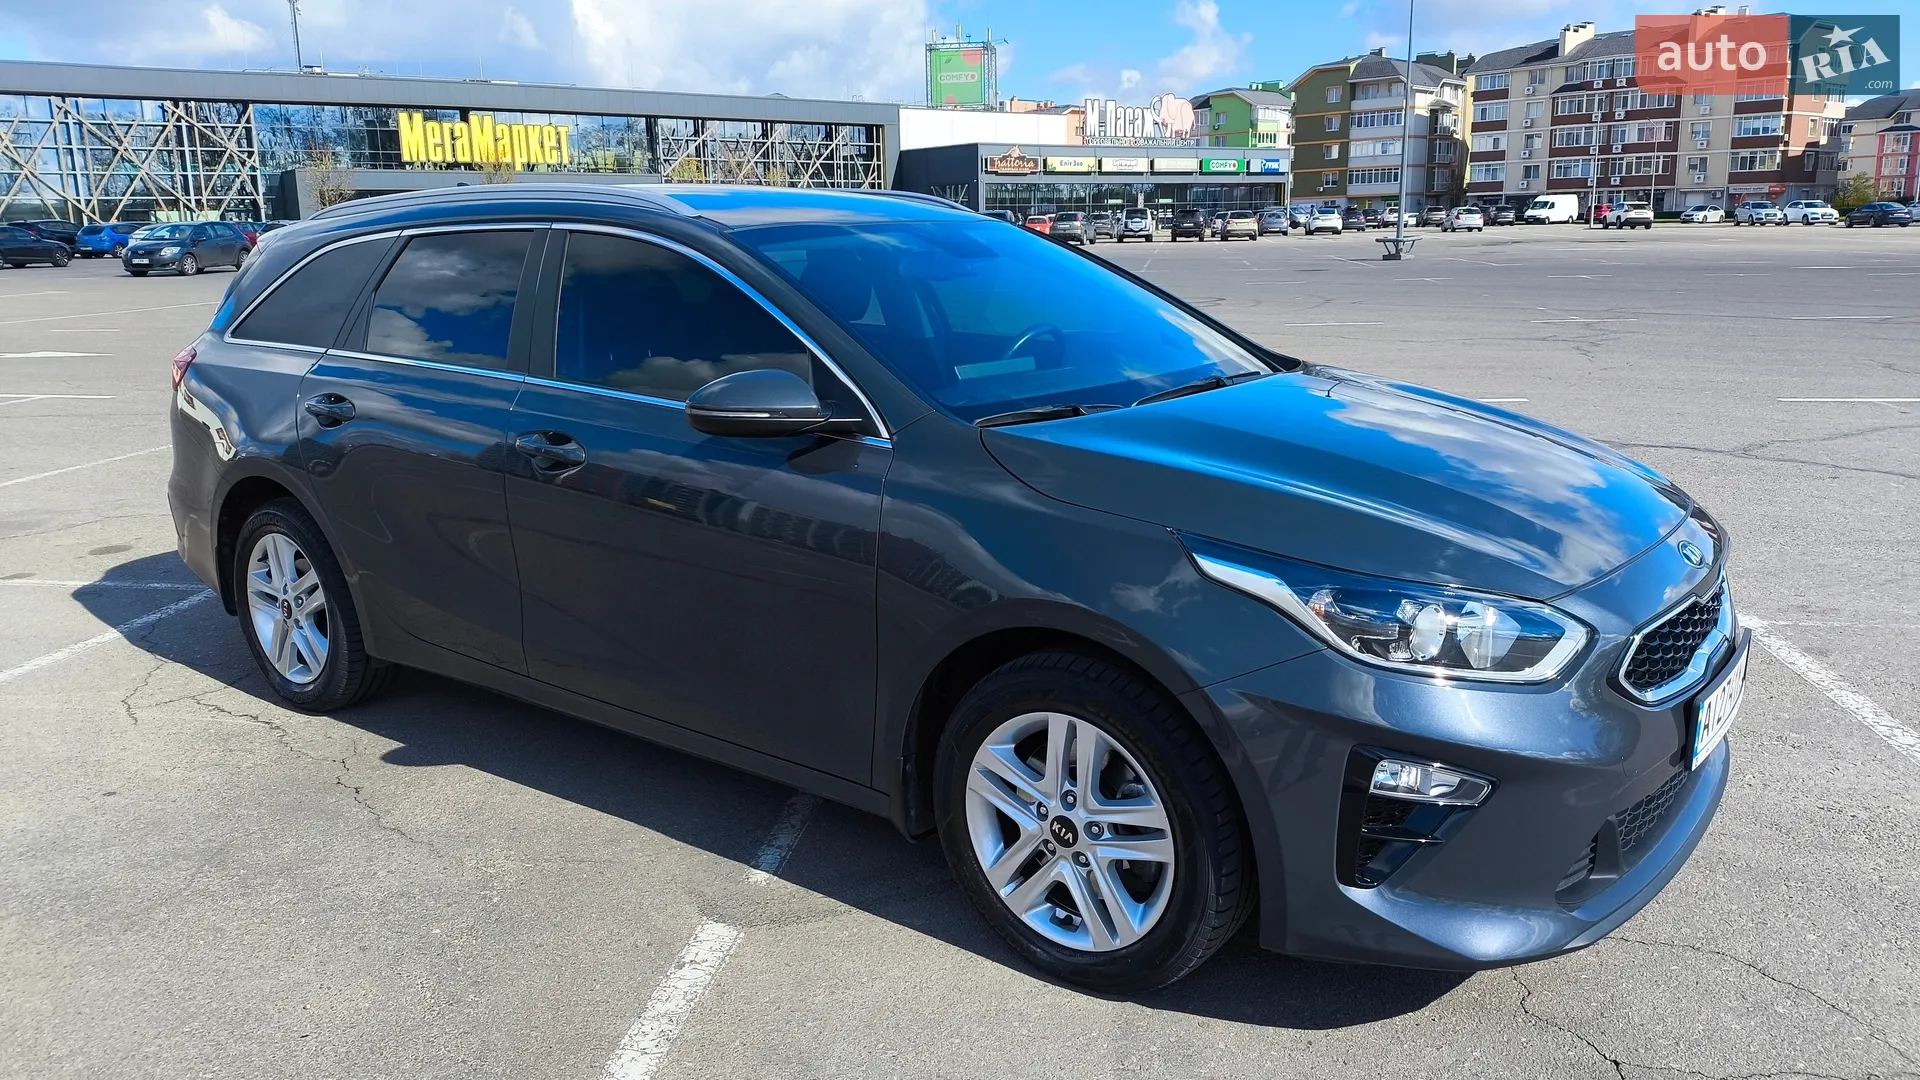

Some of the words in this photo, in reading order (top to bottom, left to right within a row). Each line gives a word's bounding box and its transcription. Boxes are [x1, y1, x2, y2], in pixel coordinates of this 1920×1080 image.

[939, 73, 970, 81] COMFY
[398, 111, 570, 171] МегаМаркет
[993, 156, 1035, 169] Trattoria
[1211, 161, 1232, 169] COMFY
[1052, 821, 1073, 844] KIA
